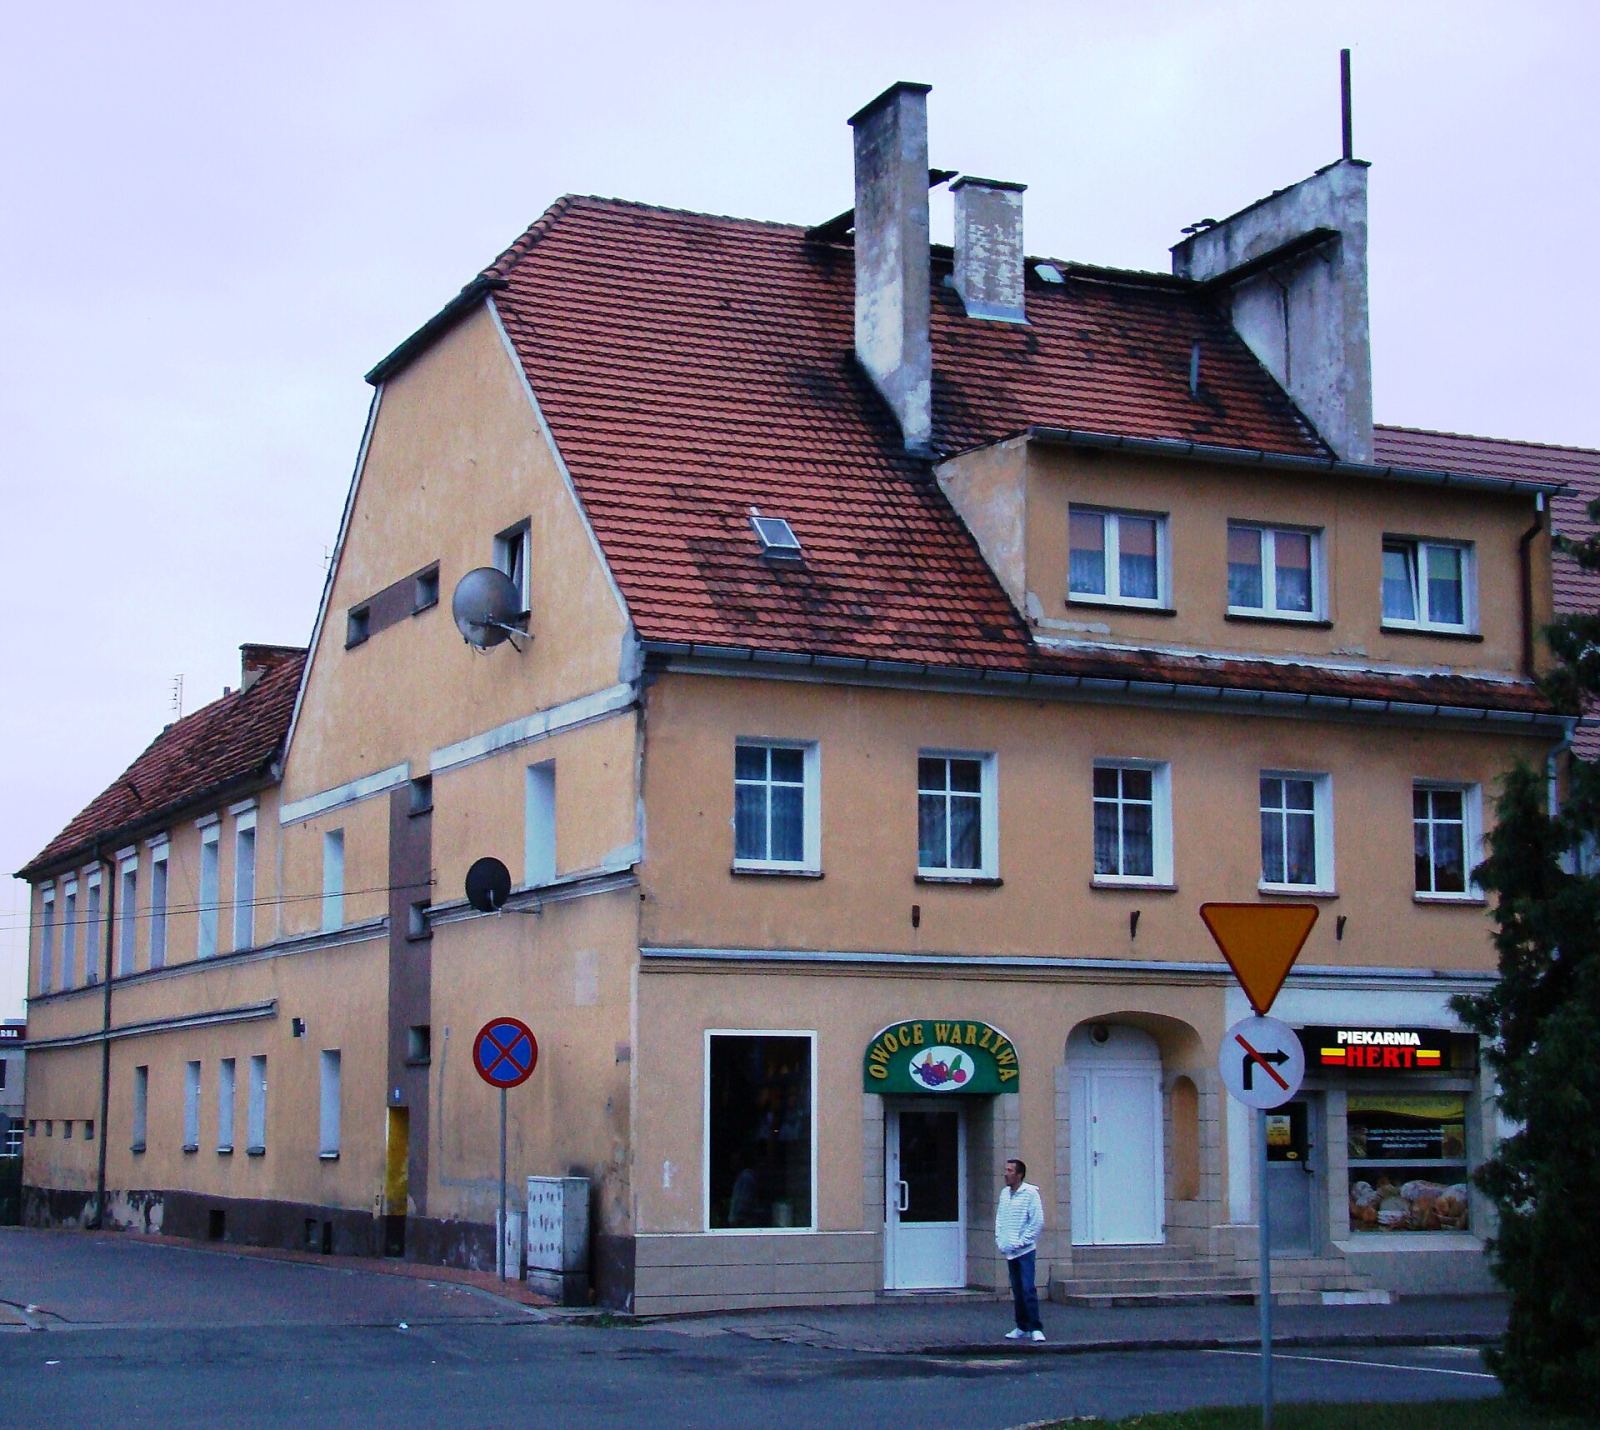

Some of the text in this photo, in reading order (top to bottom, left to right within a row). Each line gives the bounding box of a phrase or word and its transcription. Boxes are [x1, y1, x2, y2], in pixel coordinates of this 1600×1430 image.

[1337, 1031, 1421, 1045] PIEKARNIA
[868, 1023, 1018, 1082] OWOCE WARZYWA
[1347, 1046, 1415, 1067] HERT
